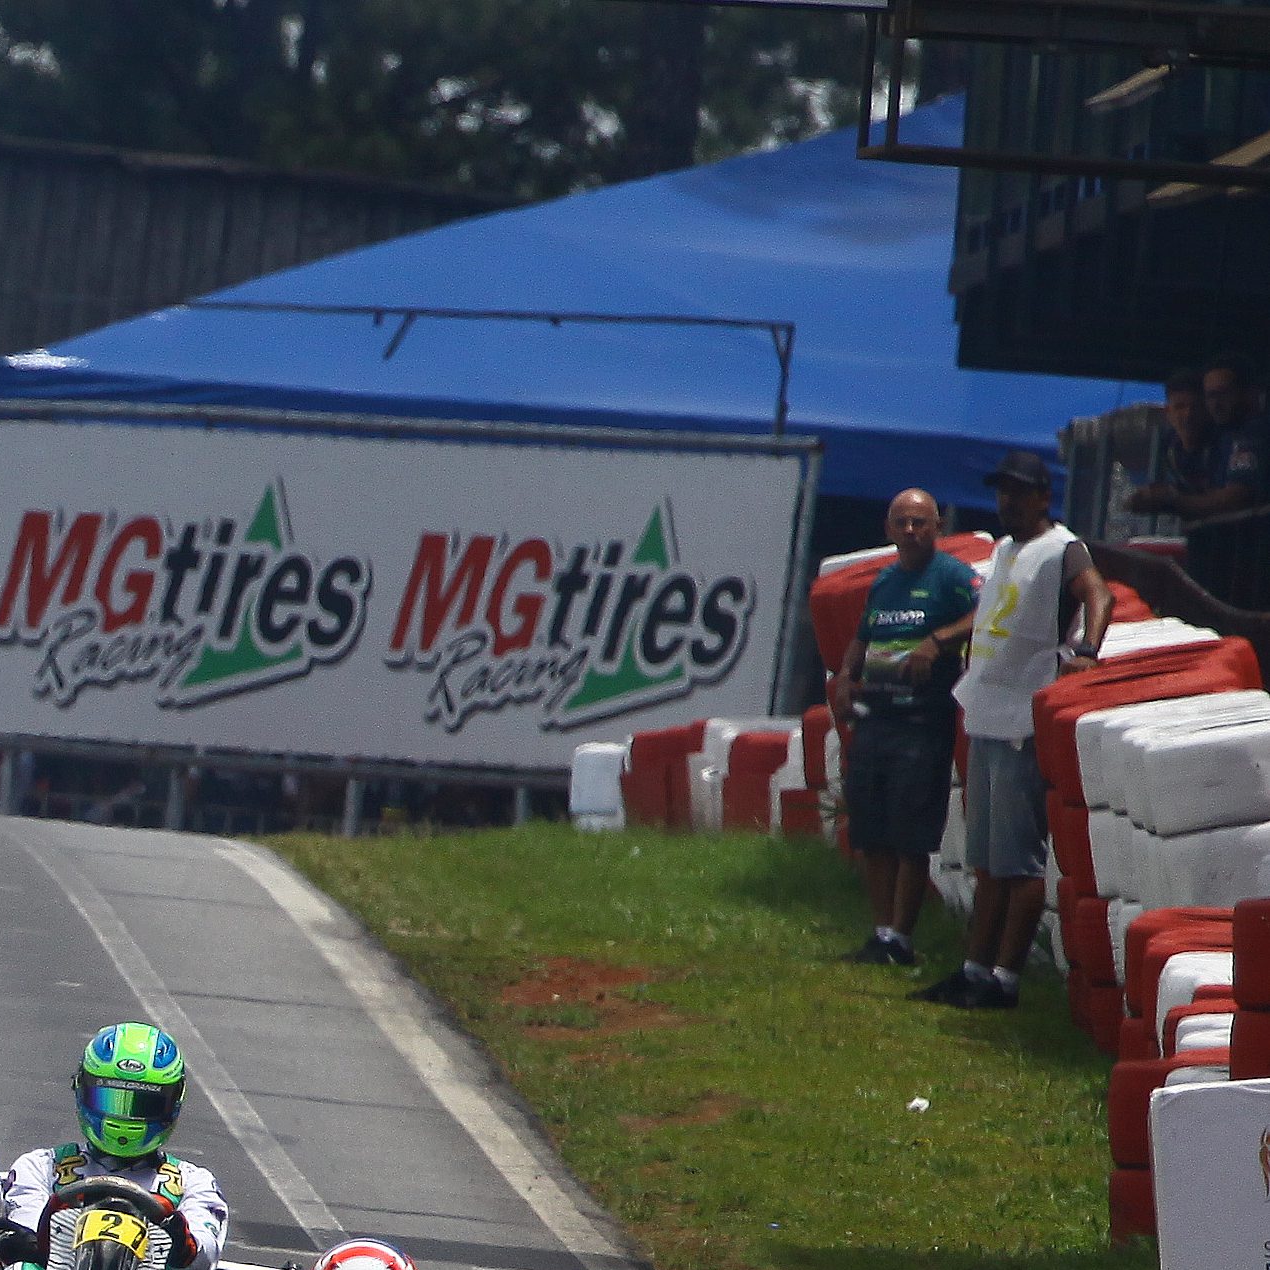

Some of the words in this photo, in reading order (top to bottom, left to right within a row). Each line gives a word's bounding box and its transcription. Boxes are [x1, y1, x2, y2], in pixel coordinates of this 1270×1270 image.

[389, 531, 747, 668] MGtires
[32, 608, 208, 706] Racing
[425, 630, 591, 732] Racing
